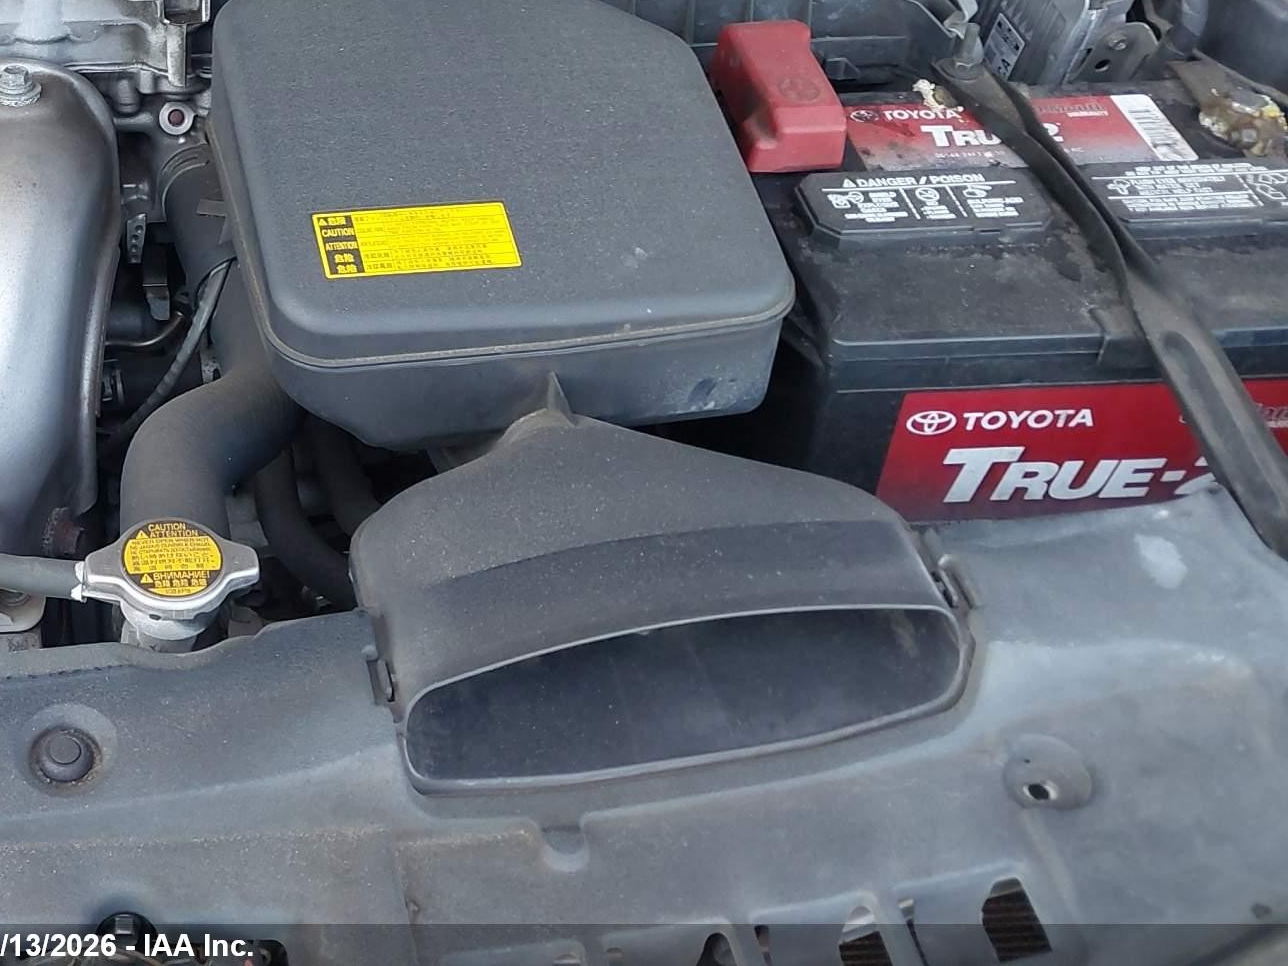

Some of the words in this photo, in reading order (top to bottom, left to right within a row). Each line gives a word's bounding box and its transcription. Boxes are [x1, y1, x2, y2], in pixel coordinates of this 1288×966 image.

[883, 108, 956, 121] TOYOTA
[856, 176, 916, 188] DANGER
[929, 173, 986, 185] POISON
[322, 228, 355, 237] CAUTION
[325, 241, 359, 251] ATTENTION
[962, 408, 1094, 432] TOYOTA
[148, 522, 186, 532] CAUTION
[149, 529, 199, 538] ATTENTION
[153, 570, 210, 580] ВНИМАНИЕ!
